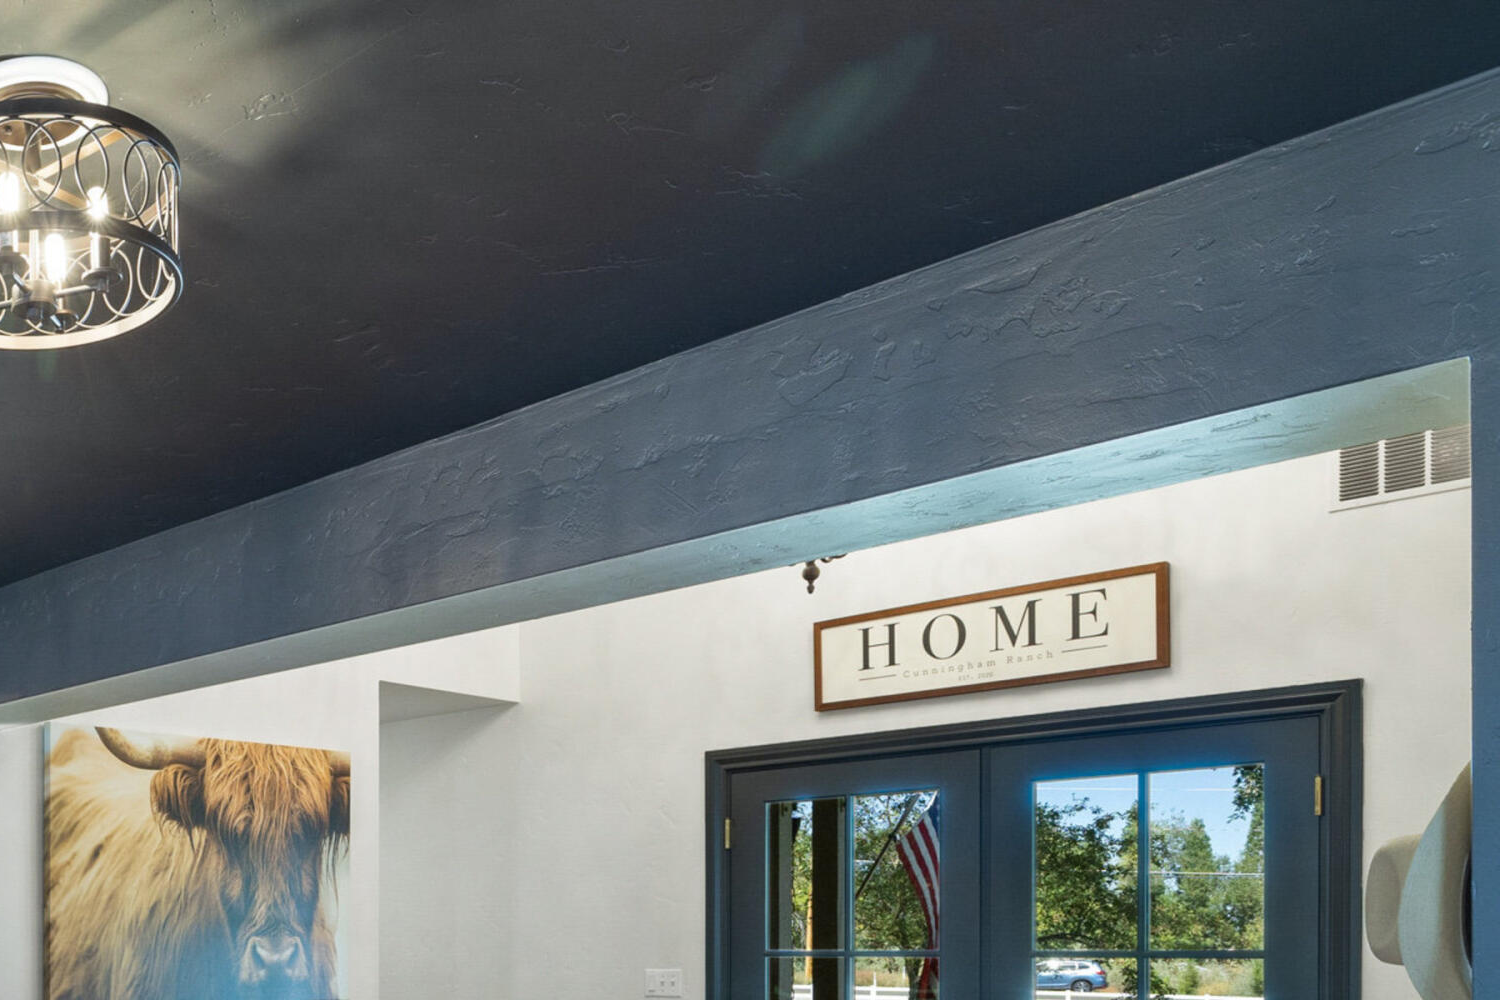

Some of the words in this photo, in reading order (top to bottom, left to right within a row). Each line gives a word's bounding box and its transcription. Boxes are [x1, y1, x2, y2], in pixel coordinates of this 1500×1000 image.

[857, 588, 1109, 671] HOME
[902, 659, 996, 678] Cunningham
[1006, 650, 1053, 664] Ranch
